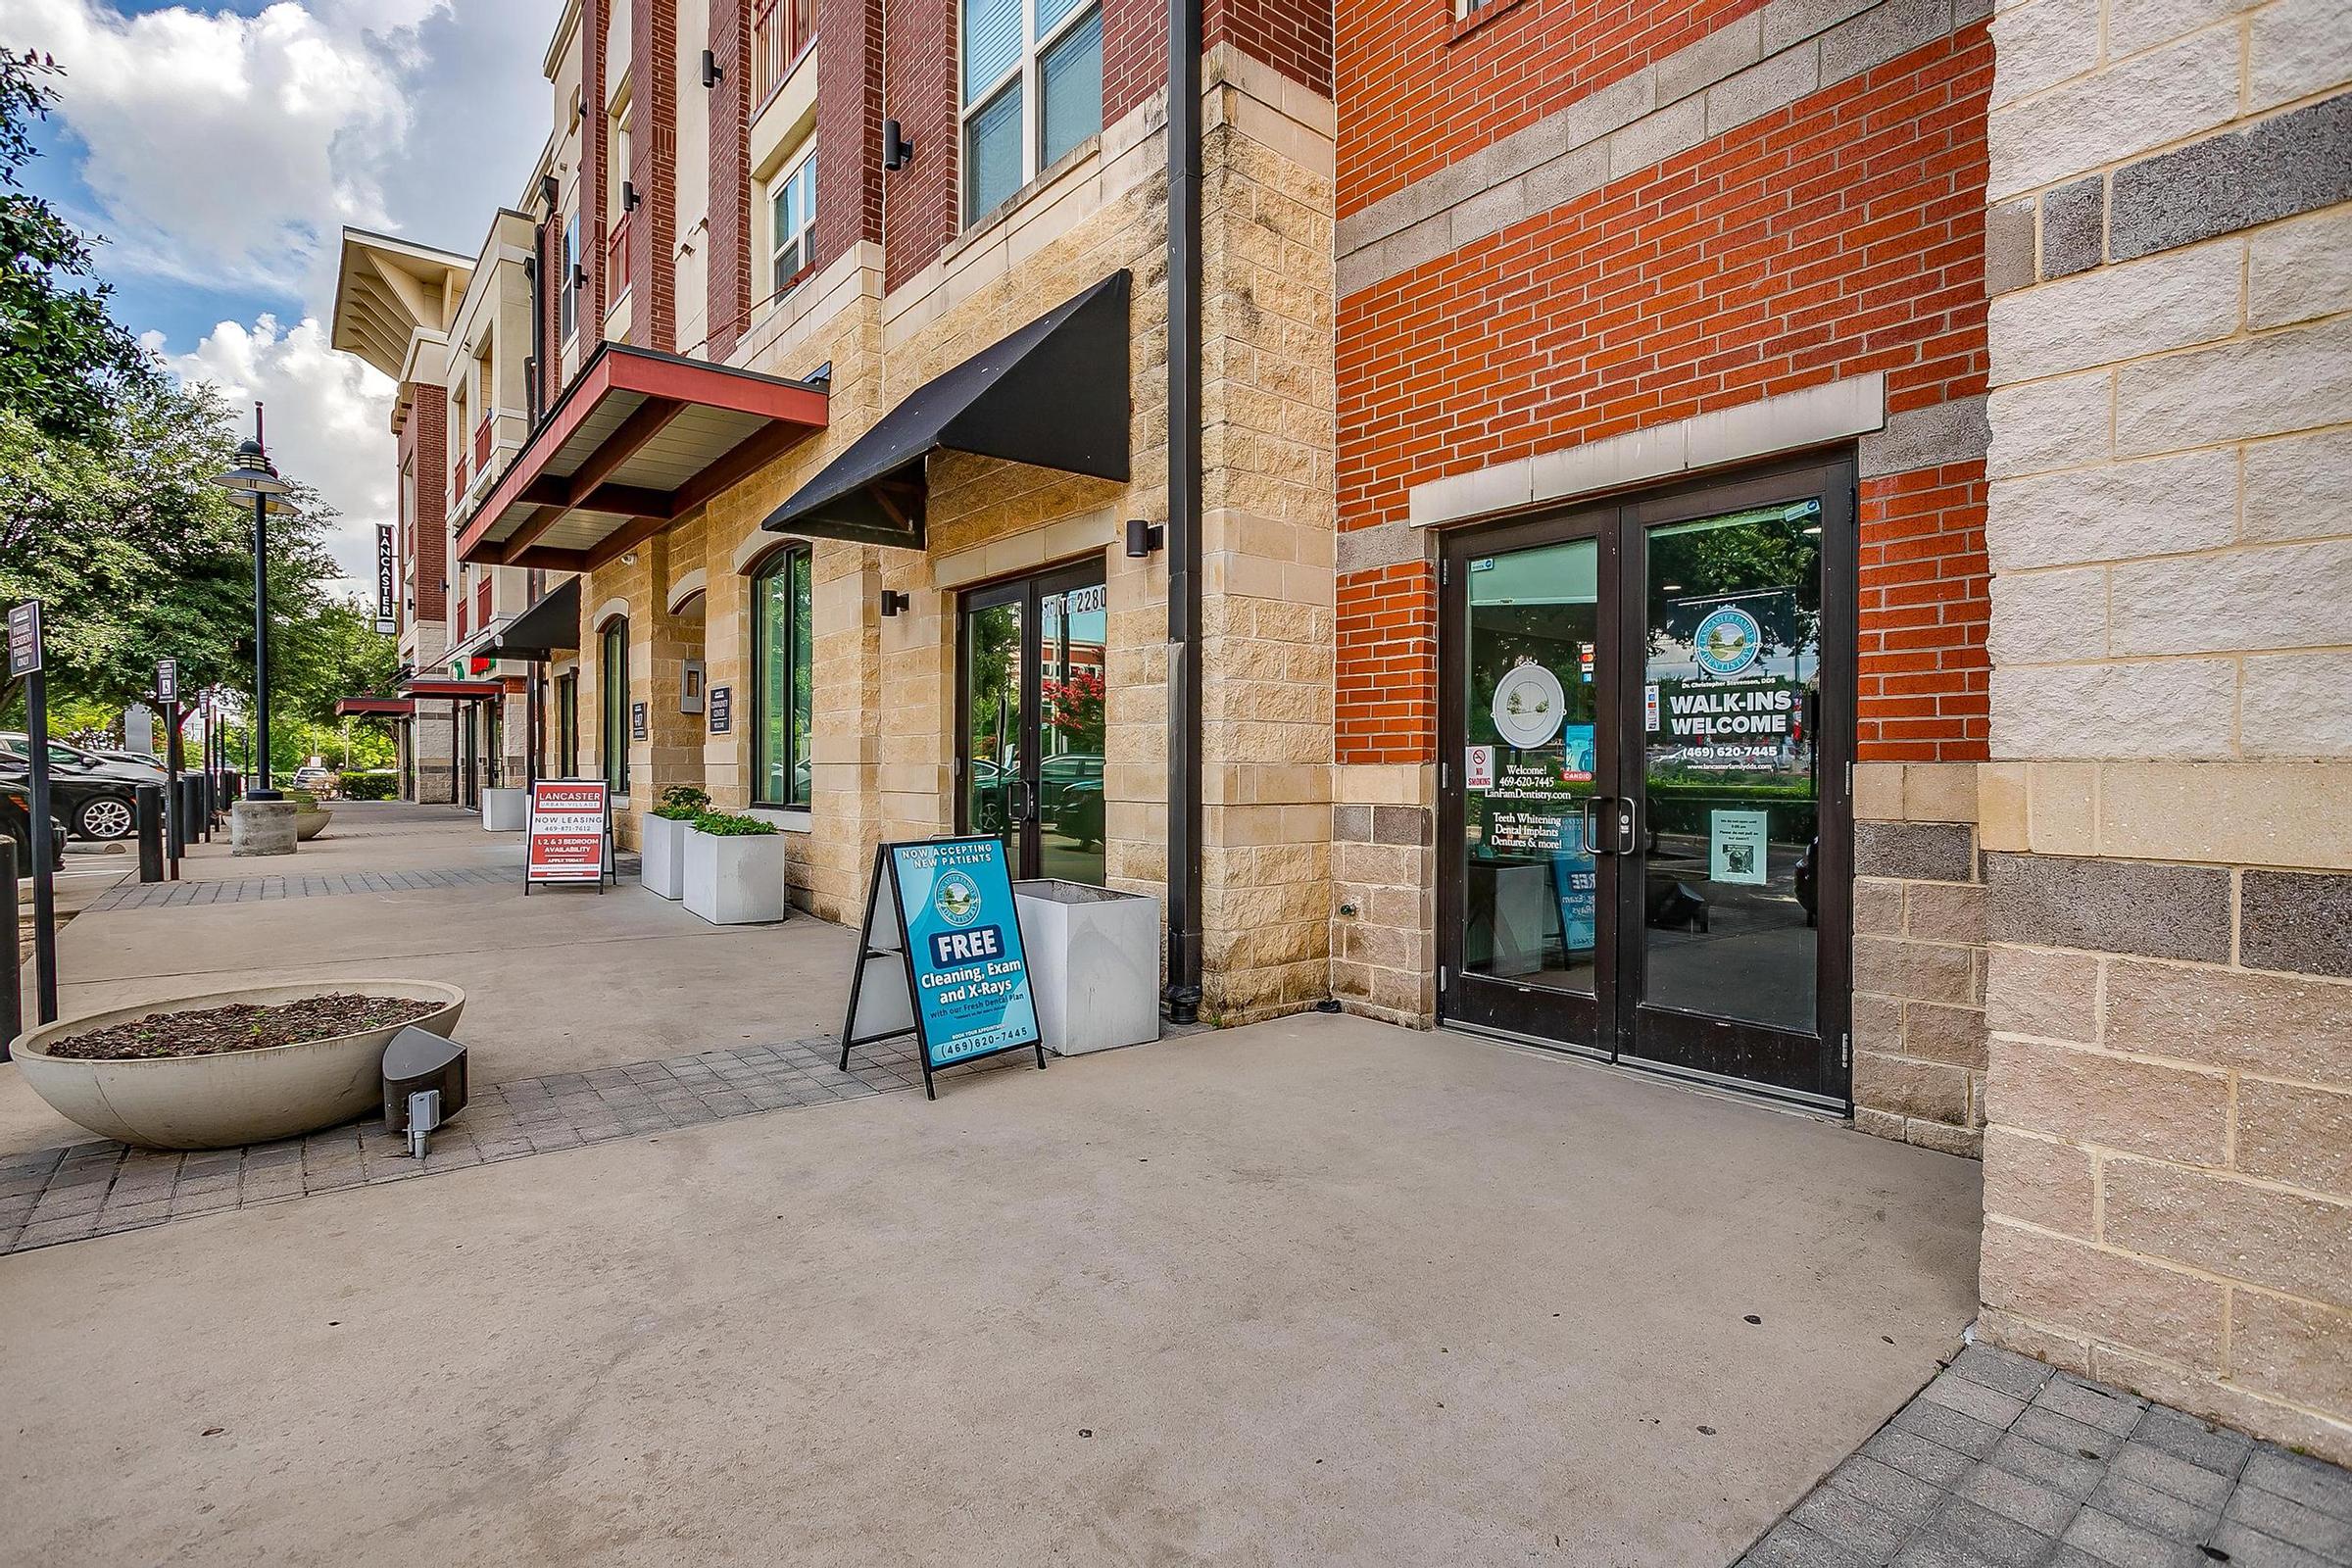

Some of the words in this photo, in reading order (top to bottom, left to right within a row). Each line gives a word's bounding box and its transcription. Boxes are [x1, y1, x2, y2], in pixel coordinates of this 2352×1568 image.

[379, 527, 391, 615] LANCASTER
[1077, 586, 1105, 612] 2280
[1669, 690, 1792, 714] WALK-INS
[1670, 714, 1787, 735] WELCOME
[1682, 747, 1714, 759] (469)
[1716, 746, 1778, 757] 620-7445
[1475, 767, 1484, 776] NO
[1506, 765, 1547, 775] Welcome!
[1468, 777, 1491, 787] SMOKING
[1499, 777, 1555, 788] 469-620-7445
[539, 792, 600, 801] LANCASTER
[1485, 788, 1572, 801] LanFamDentistry.com
[1493, 812, 1516, 823] Teeth
[1517, 812, 1561, 827] Whitening
[1494, 823, 1522, 835] Dental
[1523, 824, 1559, 838] Implants
[1491, 835, 1527, 848] Dentures
[1527, 838, 1538, 848] &
[1538, 839, 1562, 850] more!
[902, 849, 929, 859] NOW
[933, 844, 993, 858] ACCEPTING
[913, 858, 938, 869] NEW
[942, 854, 992, 866] PATIENTS
[937, 929, 998, 962] FREE
[921, 966, 985, 989] Cleaning,
[987, 959, 1021, 976] Exam
[940, 986, 965, 1004] and
[967, 979, 1012, 999] X-Rays
[963, 1000, 984, 1011] Fresh
[985, 995, 1008, 1006] Dental
[941, 1026, 1028, 1058] (469)620-7445
